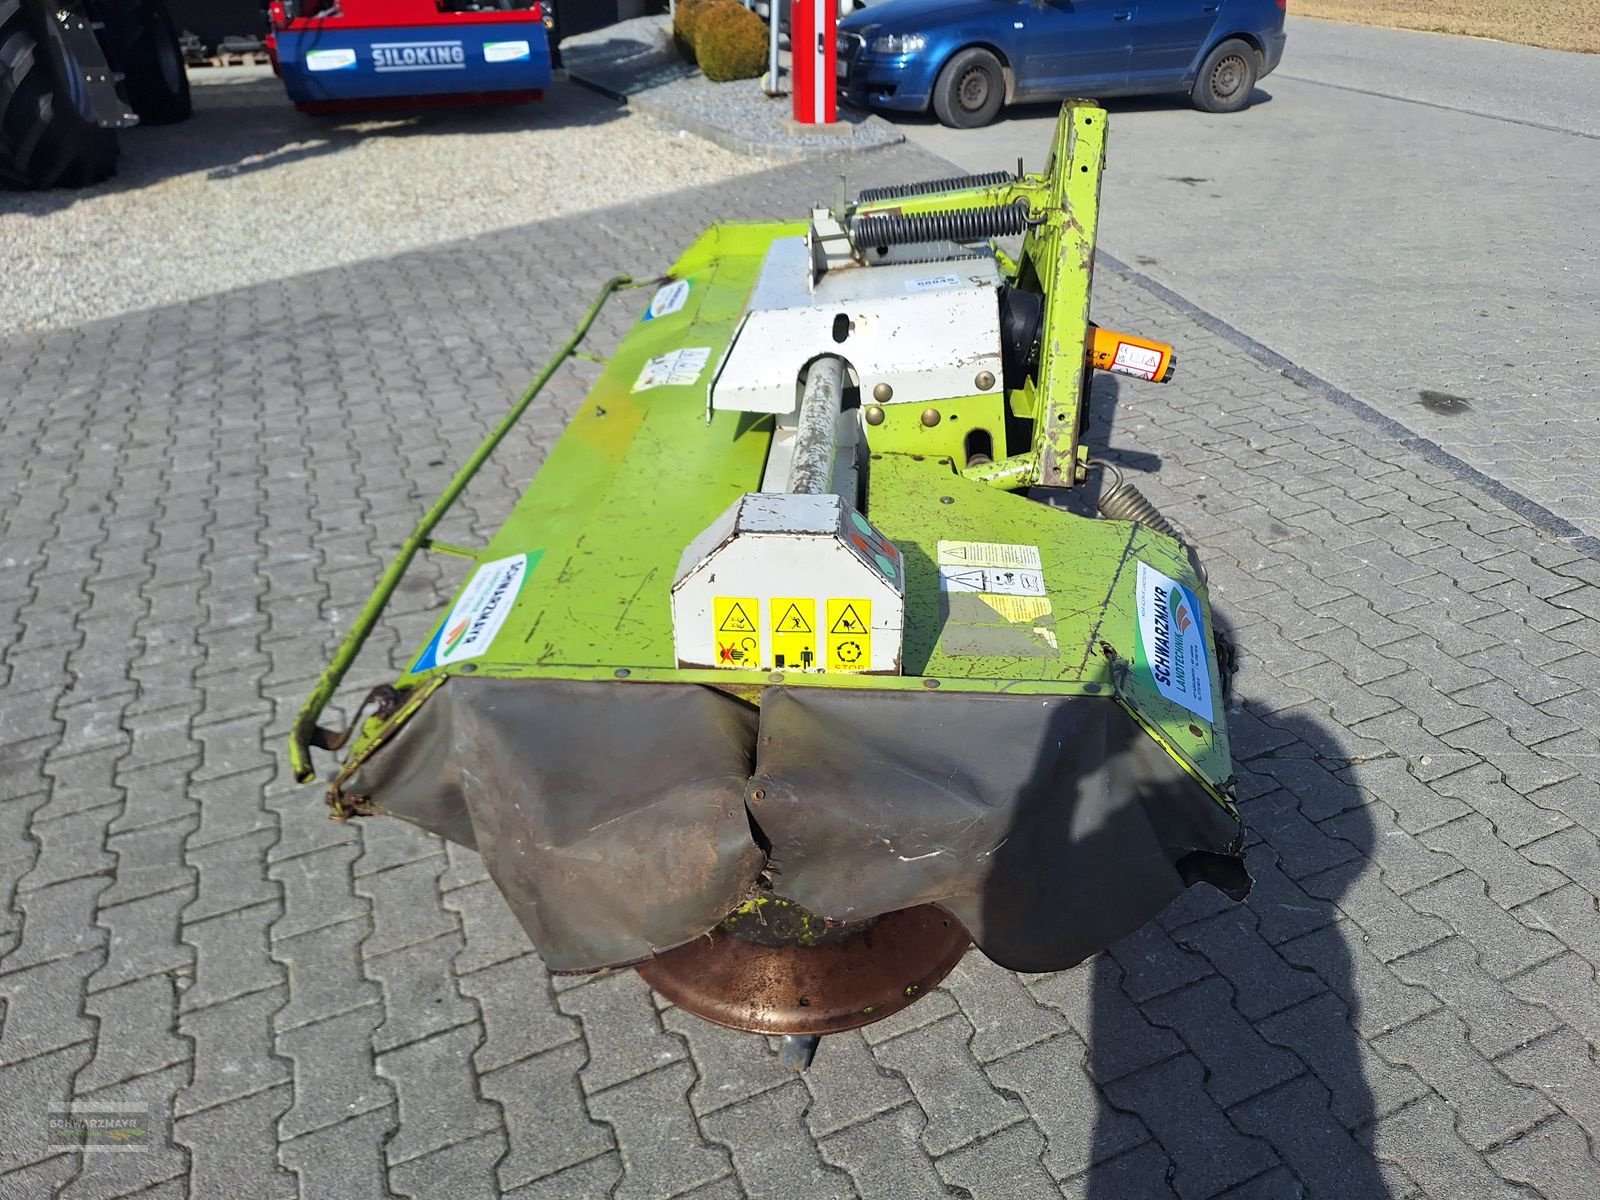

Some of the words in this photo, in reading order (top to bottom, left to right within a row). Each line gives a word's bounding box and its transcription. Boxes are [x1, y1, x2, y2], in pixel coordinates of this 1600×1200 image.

[371, 46, 465, 66] SILOKING
[1154, 586, 1171, 687] SCHWARZMAYR
[1174, 632, 1187, 694] LANDTECHNIK
